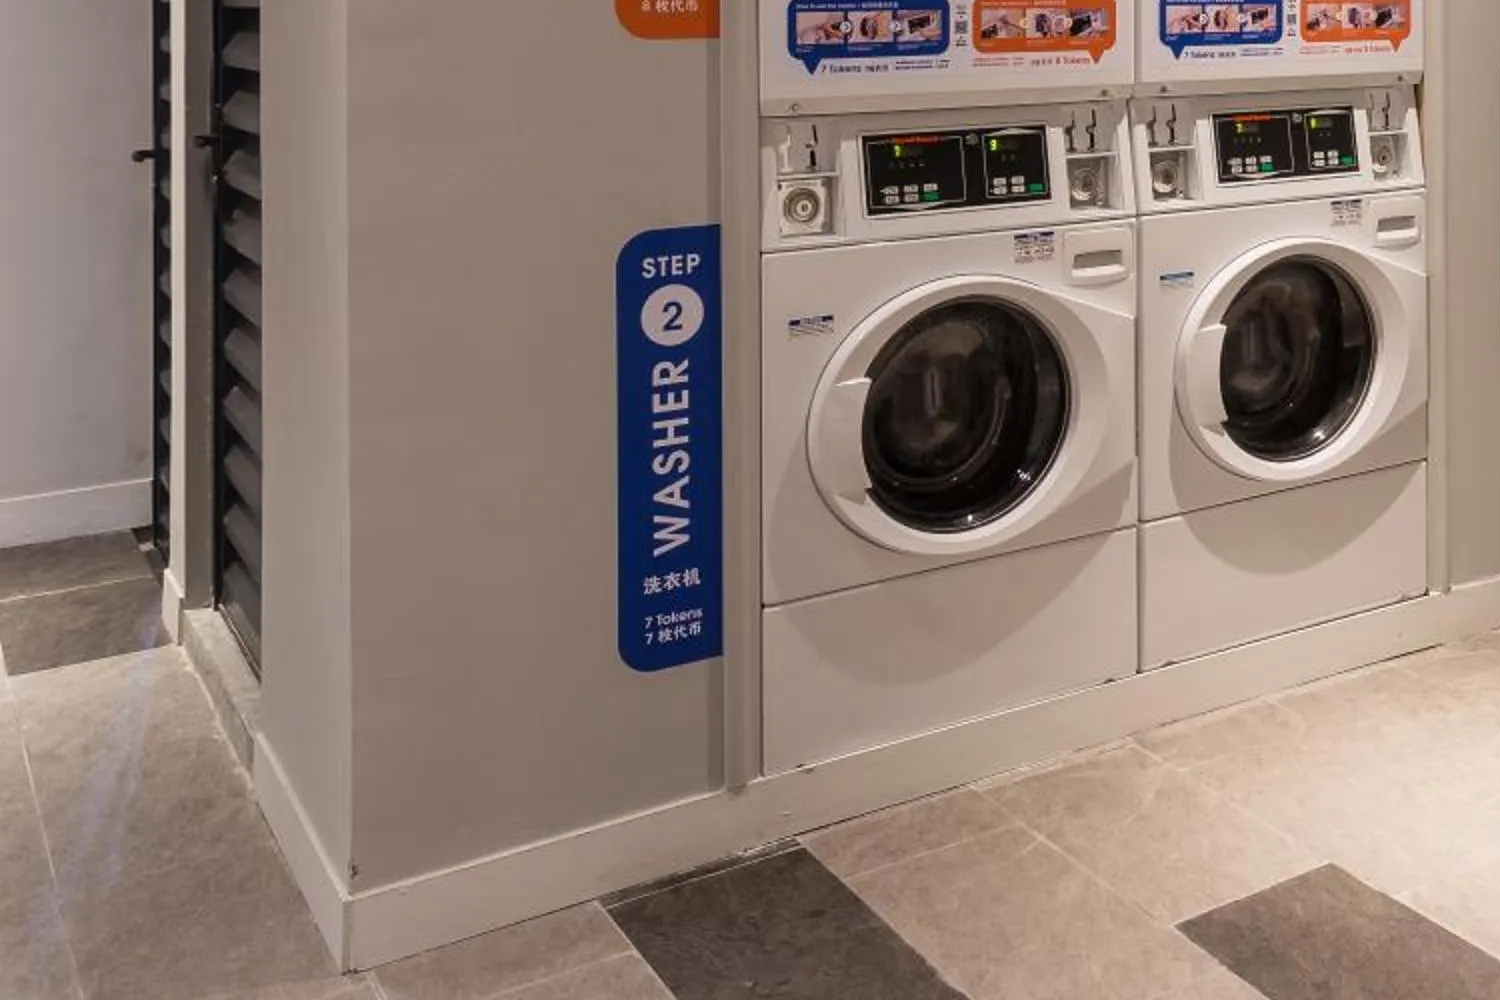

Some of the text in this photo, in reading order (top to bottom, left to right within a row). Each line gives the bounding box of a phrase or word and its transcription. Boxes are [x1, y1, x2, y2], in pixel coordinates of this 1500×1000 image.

[641, 253, 701, 279] STEP
[662, 301, 683, 331] 2
[652, 358, 689, 557] WASHER
[643, 567, 702, 595] 洗衣机
[644, 608, 703, 629] 7 Tokens
[645, 633, 653, 645] 7
